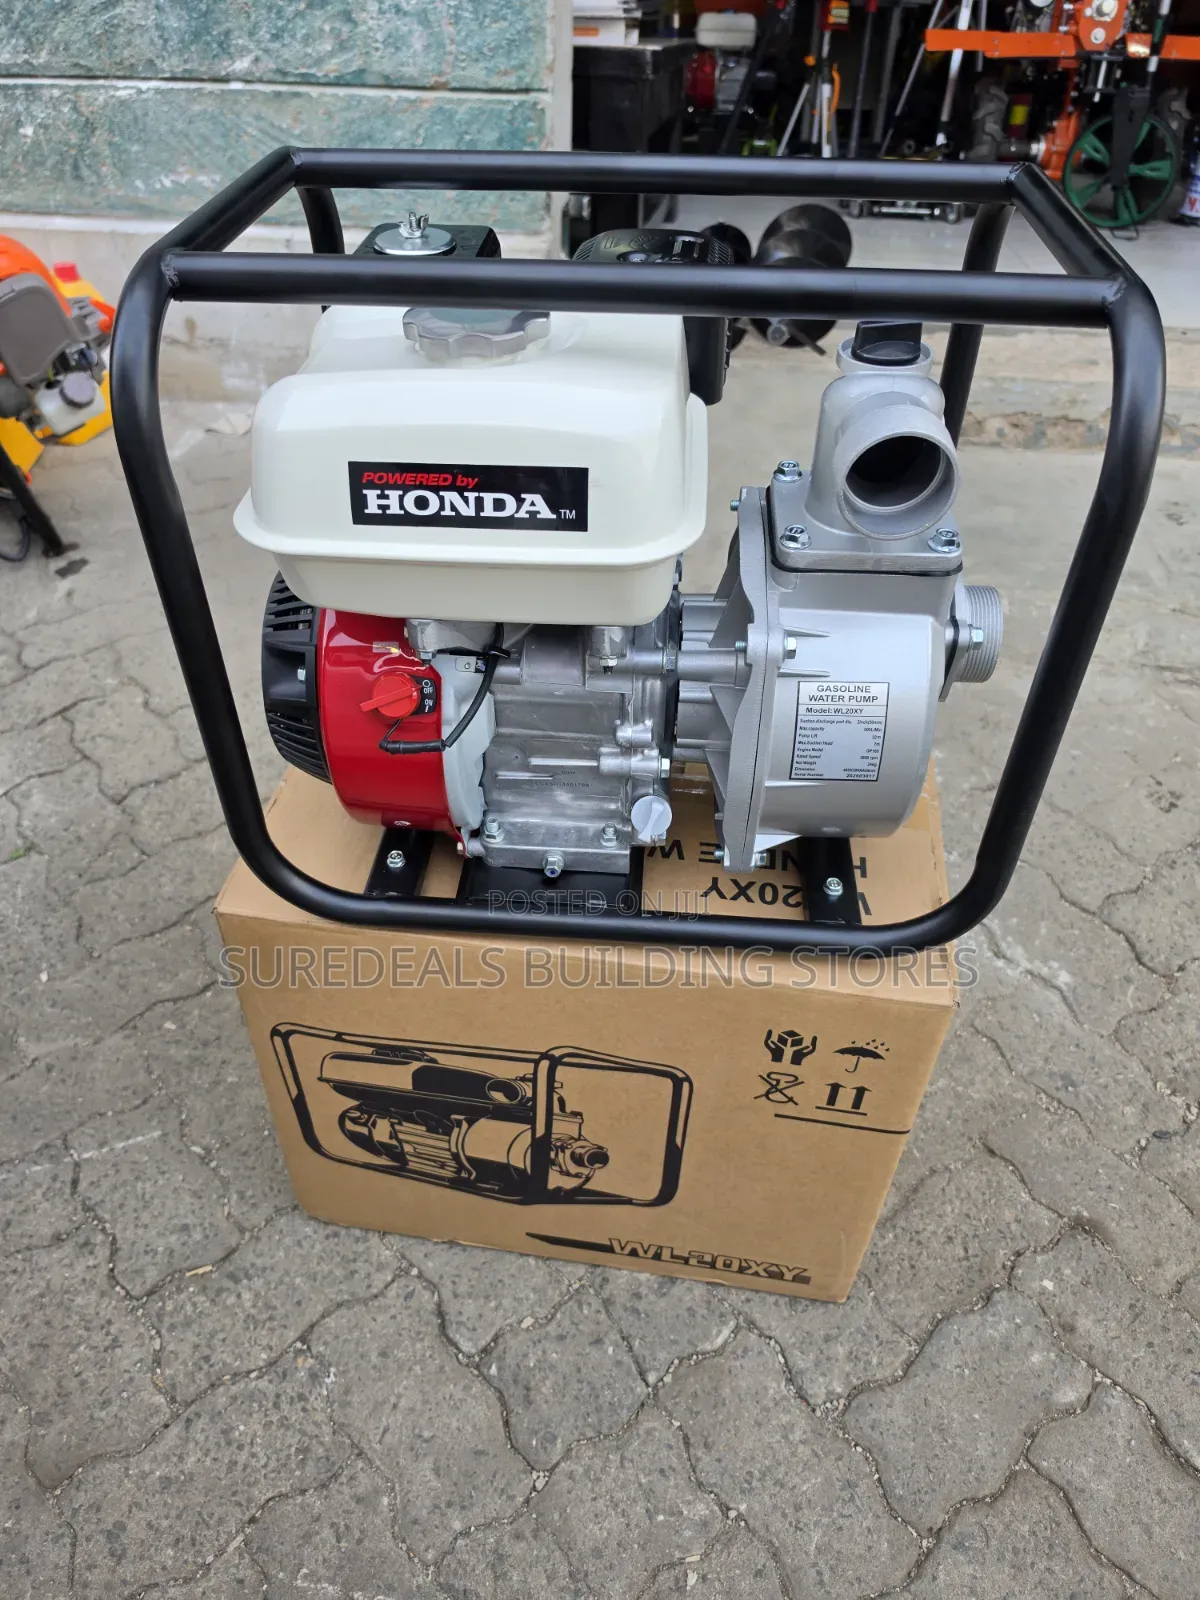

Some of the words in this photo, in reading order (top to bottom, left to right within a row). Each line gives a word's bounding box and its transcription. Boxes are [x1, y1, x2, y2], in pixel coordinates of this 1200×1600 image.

[362, 472, 452, 486] POWERED
[456, 474, 479, 489] by
[363, 489, 557, 519] HONDA
[816, 684, 871, 693] GASOLINE
[808, 694, 845, 703] WATER
[848, 695, 879, 703] PUMP
[608, 1237, 809, 1282] WL20XY
